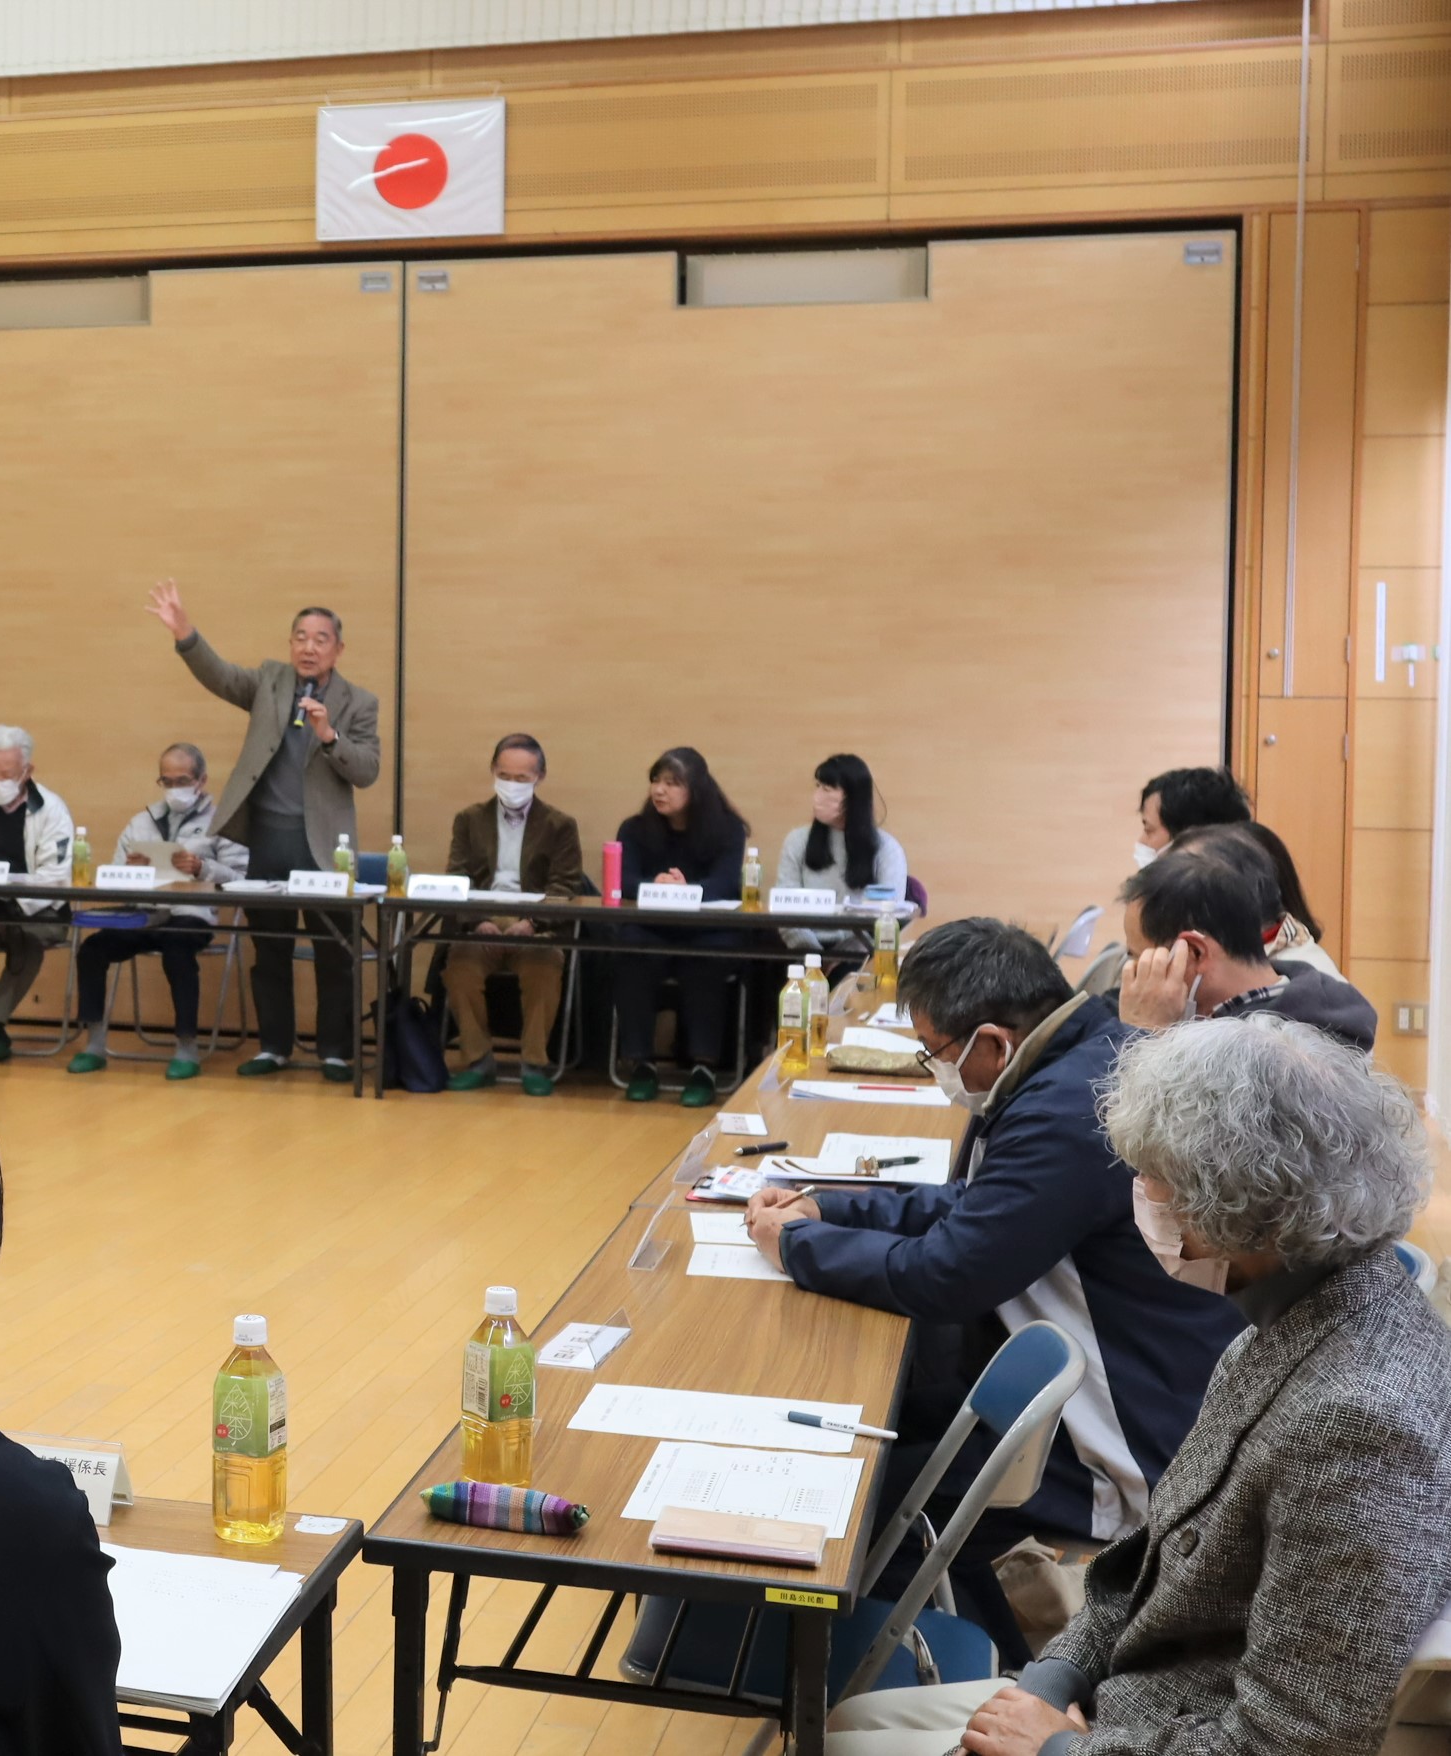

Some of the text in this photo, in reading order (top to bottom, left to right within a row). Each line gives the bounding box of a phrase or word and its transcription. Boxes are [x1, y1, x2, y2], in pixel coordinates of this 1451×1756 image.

[779, 1592, 825, 1605] 田島公民館
